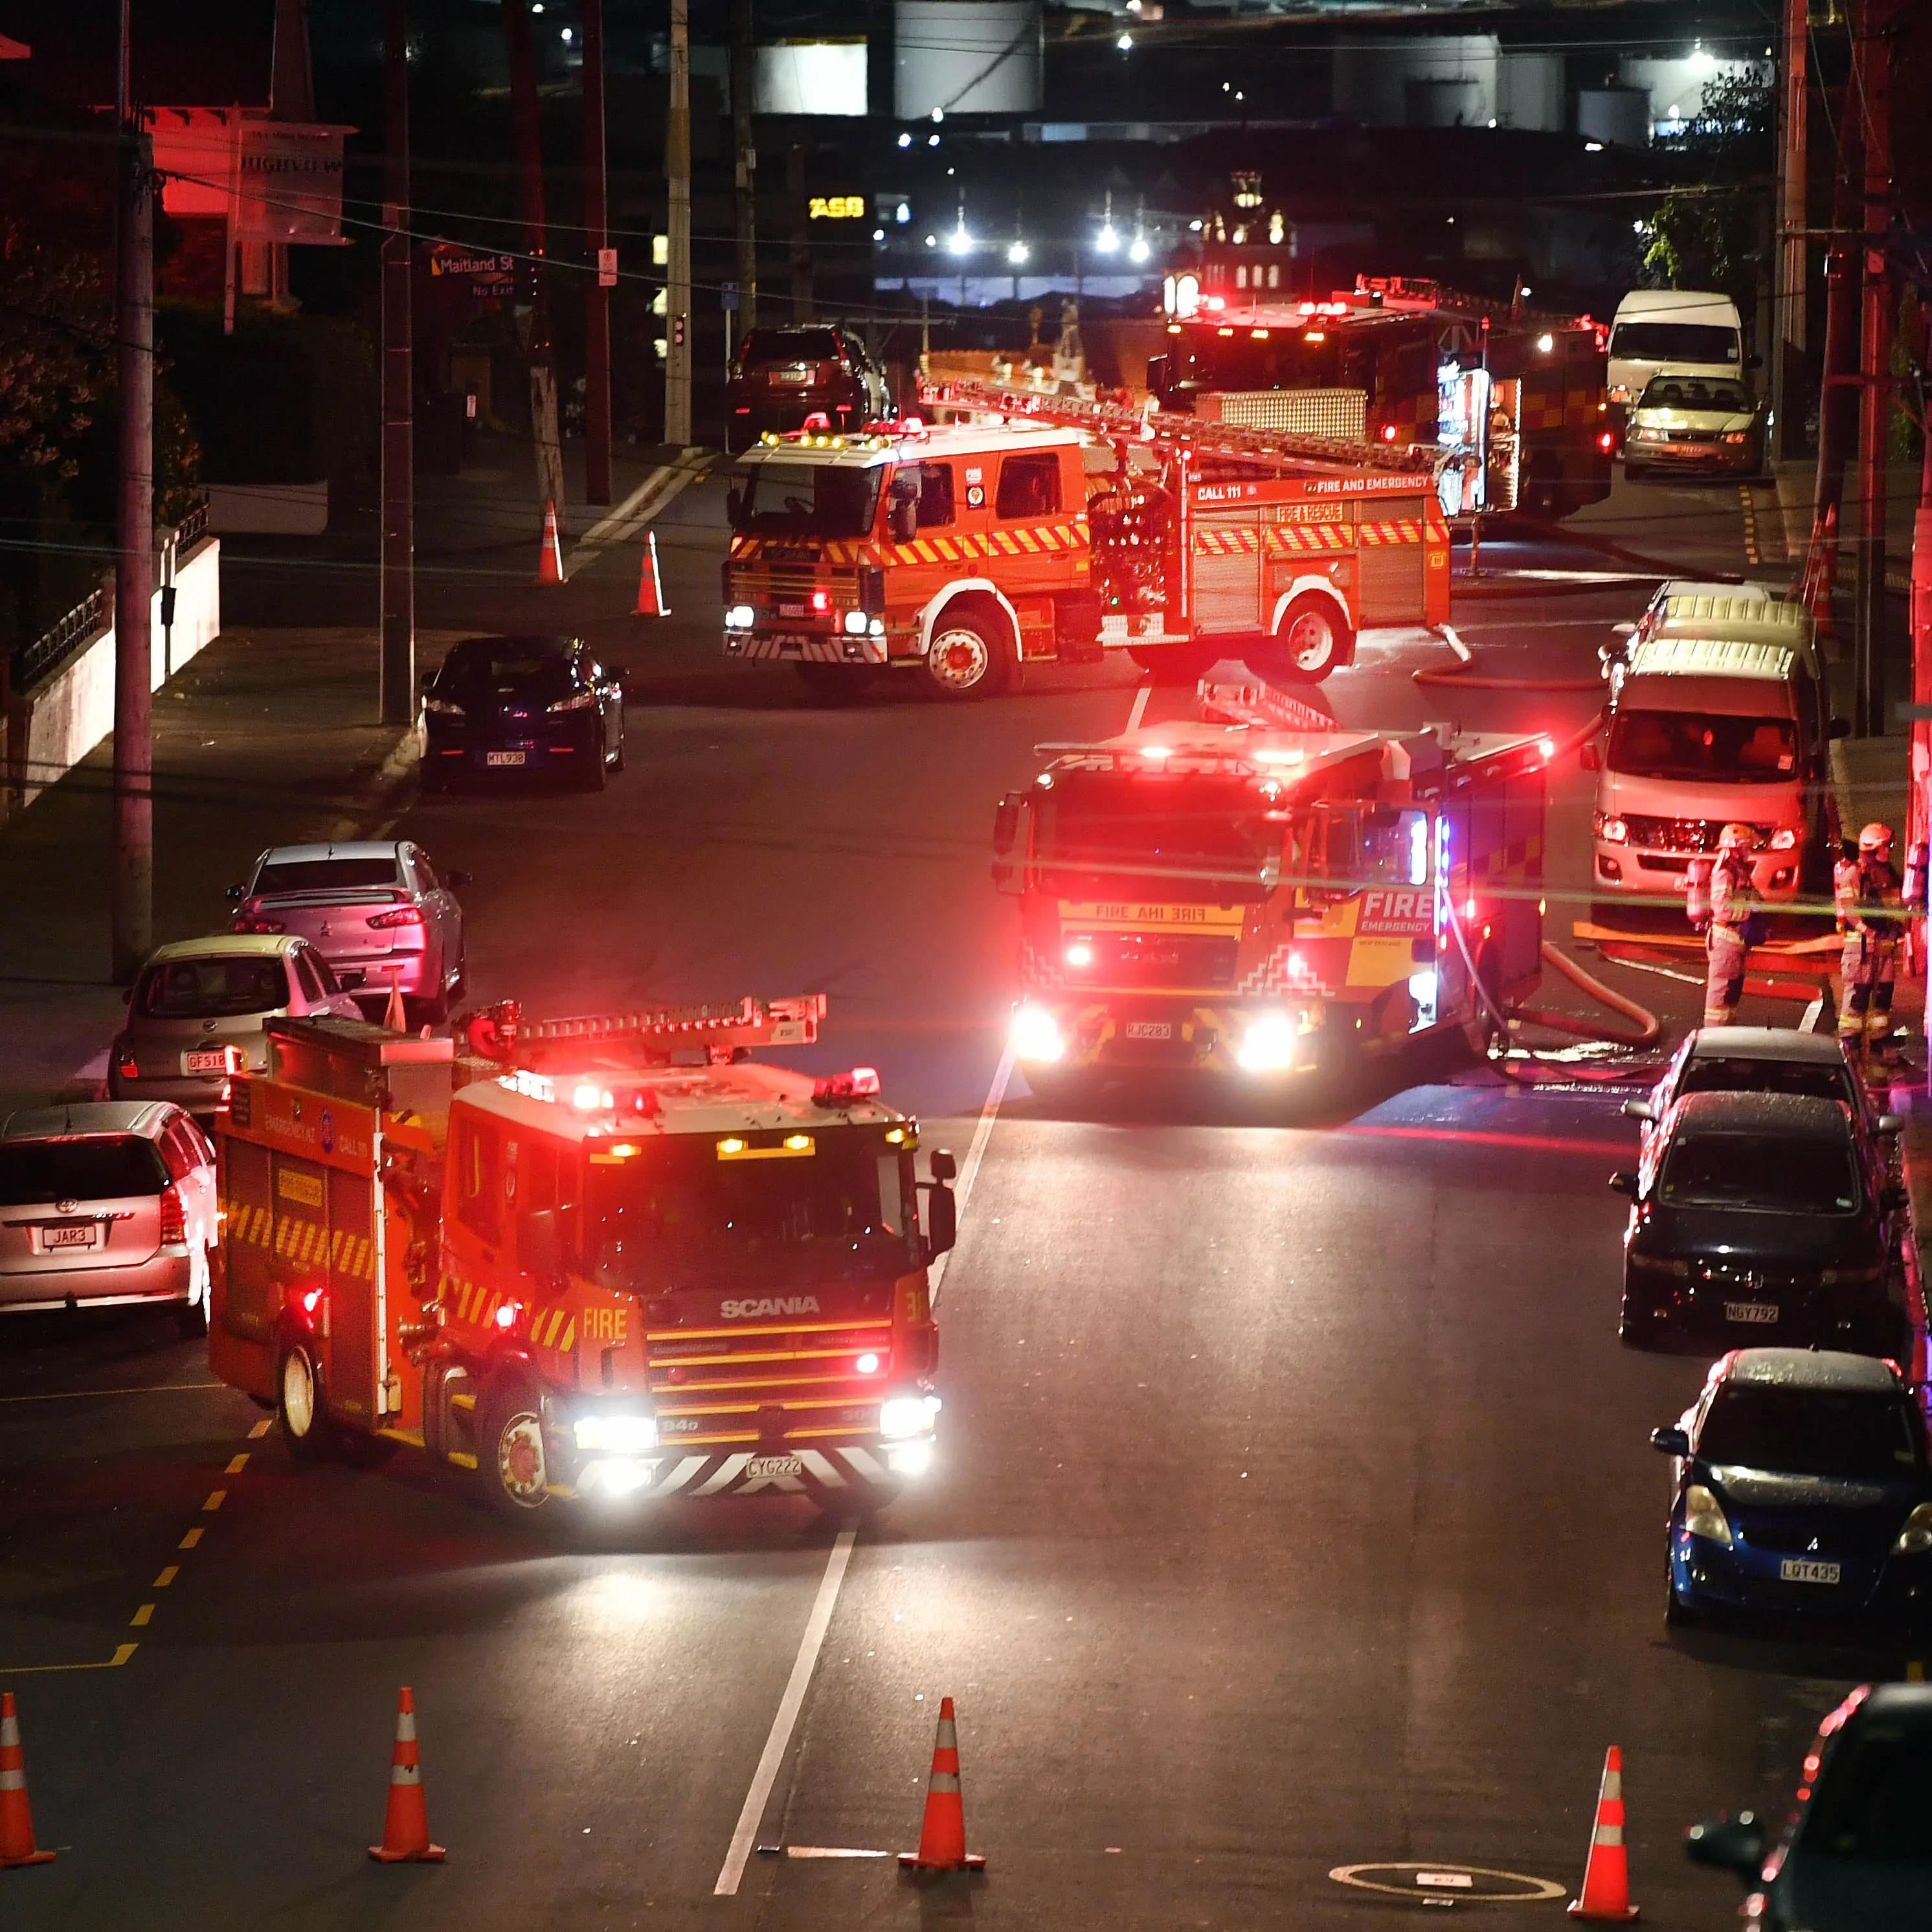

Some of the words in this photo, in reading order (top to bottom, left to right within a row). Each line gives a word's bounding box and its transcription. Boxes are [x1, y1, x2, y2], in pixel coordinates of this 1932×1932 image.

[809, 196, 864, 219] ASB
[440, 256, 495, 274] Maitland
[500, 255, 514, 271] St
[473, 286, 488, 296] No
[492, 284, 514, 296] Exit
[1198, 486, 1225, 500] CALL
[1226, 485, 1241, 498] 111
[1317, 479, 1341, 493] FIRE
[1342, 478, 1364, 491] AND
[1366, 476, 1428, 490] EMERGENCY
[1095, 904, 1130, 919] FIRE
[1138, 906, 1164, 921] AHI
[1364, 892, 1433, 918] FIRE
[1361, 921, 1430, 932] EMERGENCY
[55, 1230, 86, 1243] JAR3
[721, 1296, 821, 1318] SCANIA
[584, 1308, 627, 1339] FIRE
[748, 1457, 800, 1476] CYG222
